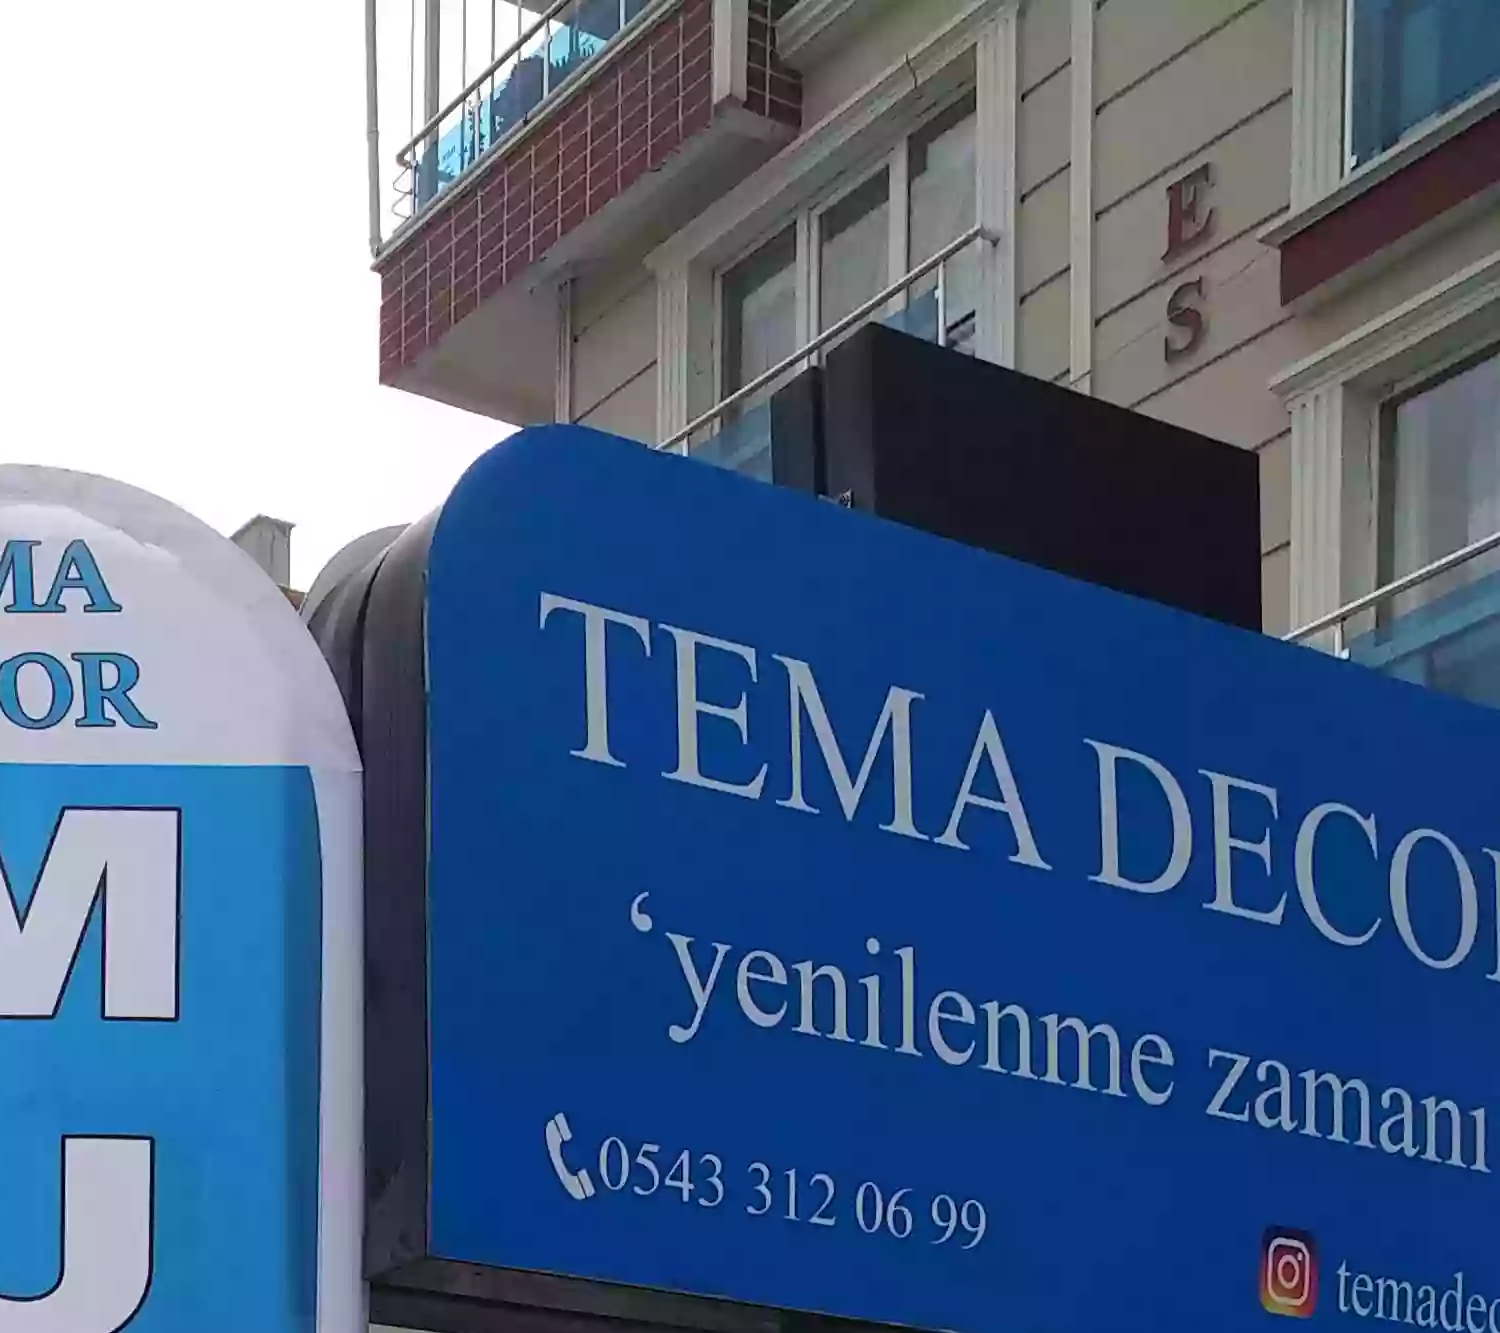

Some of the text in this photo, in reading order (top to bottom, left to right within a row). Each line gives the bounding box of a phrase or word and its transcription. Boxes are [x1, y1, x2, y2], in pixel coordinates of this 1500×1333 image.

[539, 591, 1500, 983] TEMA DECO
[1205, 1047, 1493, 1174] zamanı
[599, 1135, 988, 1250] 0543 312 06 99
